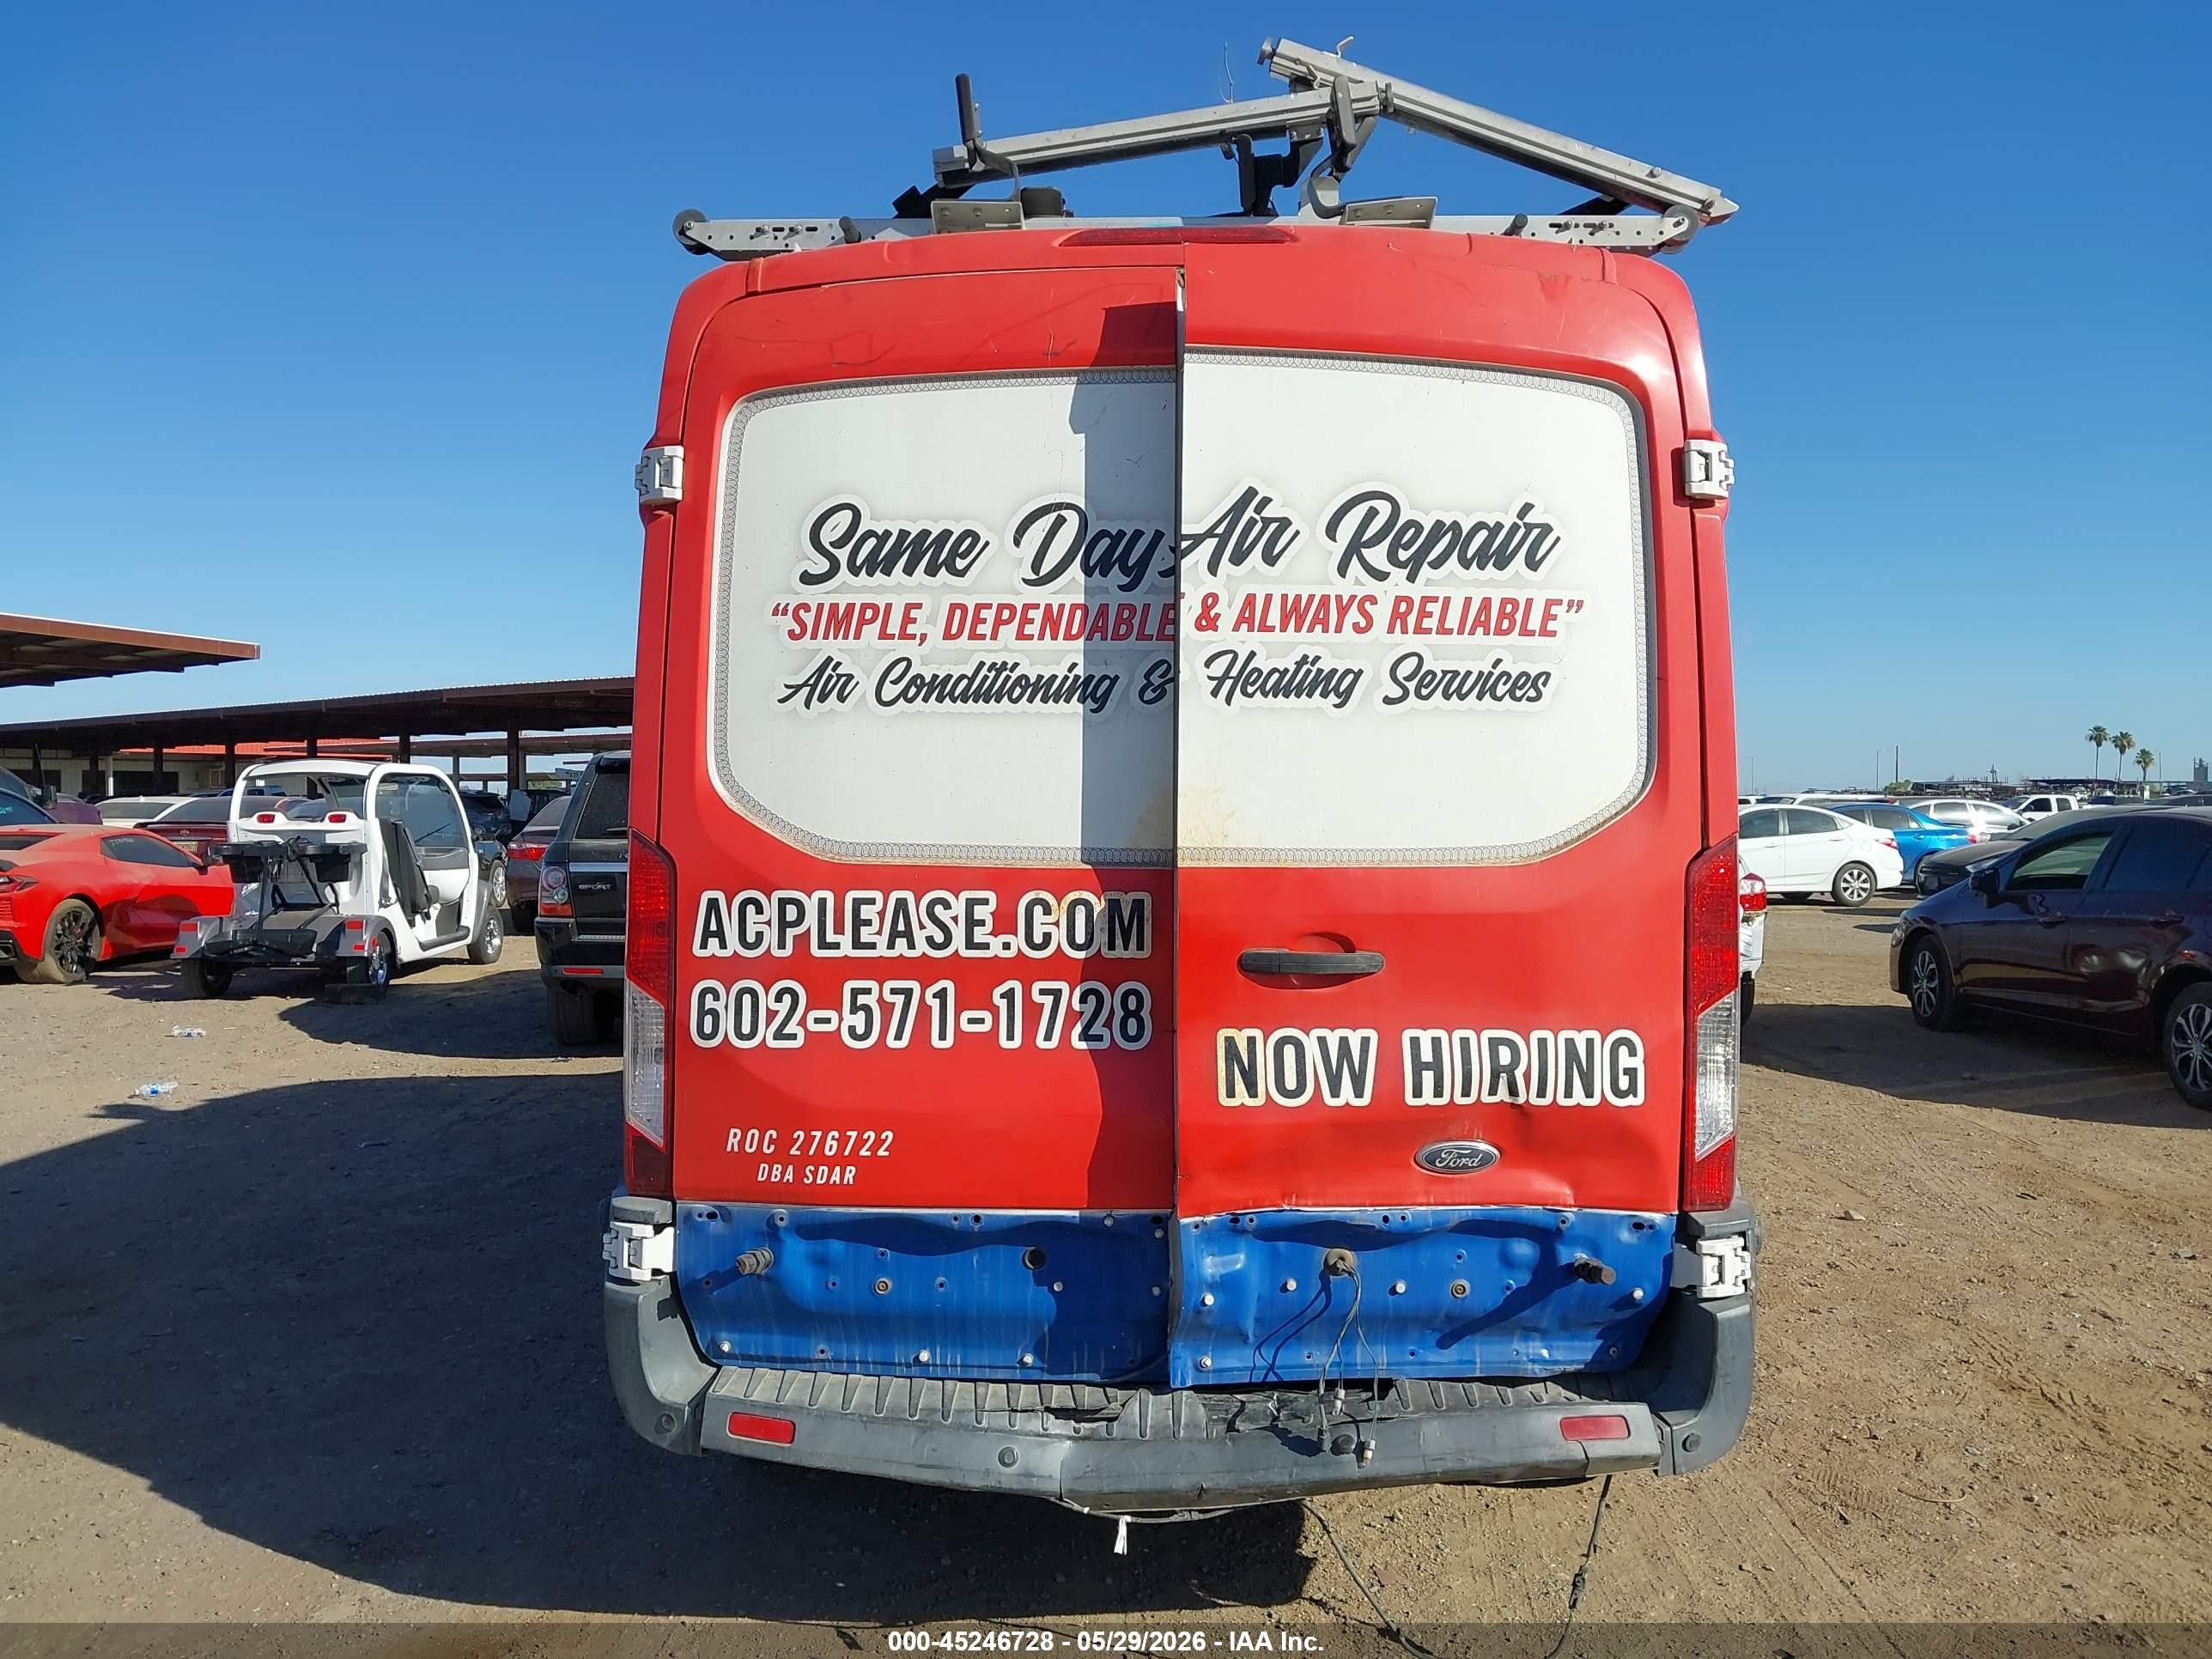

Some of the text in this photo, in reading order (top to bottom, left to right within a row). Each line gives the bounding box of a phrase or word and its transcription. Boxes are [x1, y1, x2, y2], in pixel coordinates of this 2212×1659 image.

[799, 486, 1561, 592] Same Day Air Repair
[771, 592, 1583, 647] “SIMPLE, DEPENDABLE & ALWAYS RELIABLE”
[777, 649, 1552, 713] Air Conditioning & Heating Services
[696, 893, 1148, 955] ACPLEASE.COM
[693, 983, 1149, 1046] 602-571-1728
[1220, 1031, 1643, 1103] NOW HIRING
[726, 1127, 895, 1158] ROC 276722
[1435, 1149, 1483, 1168] Ford
[757, 1163, 857, 1185] DBA SDAR
